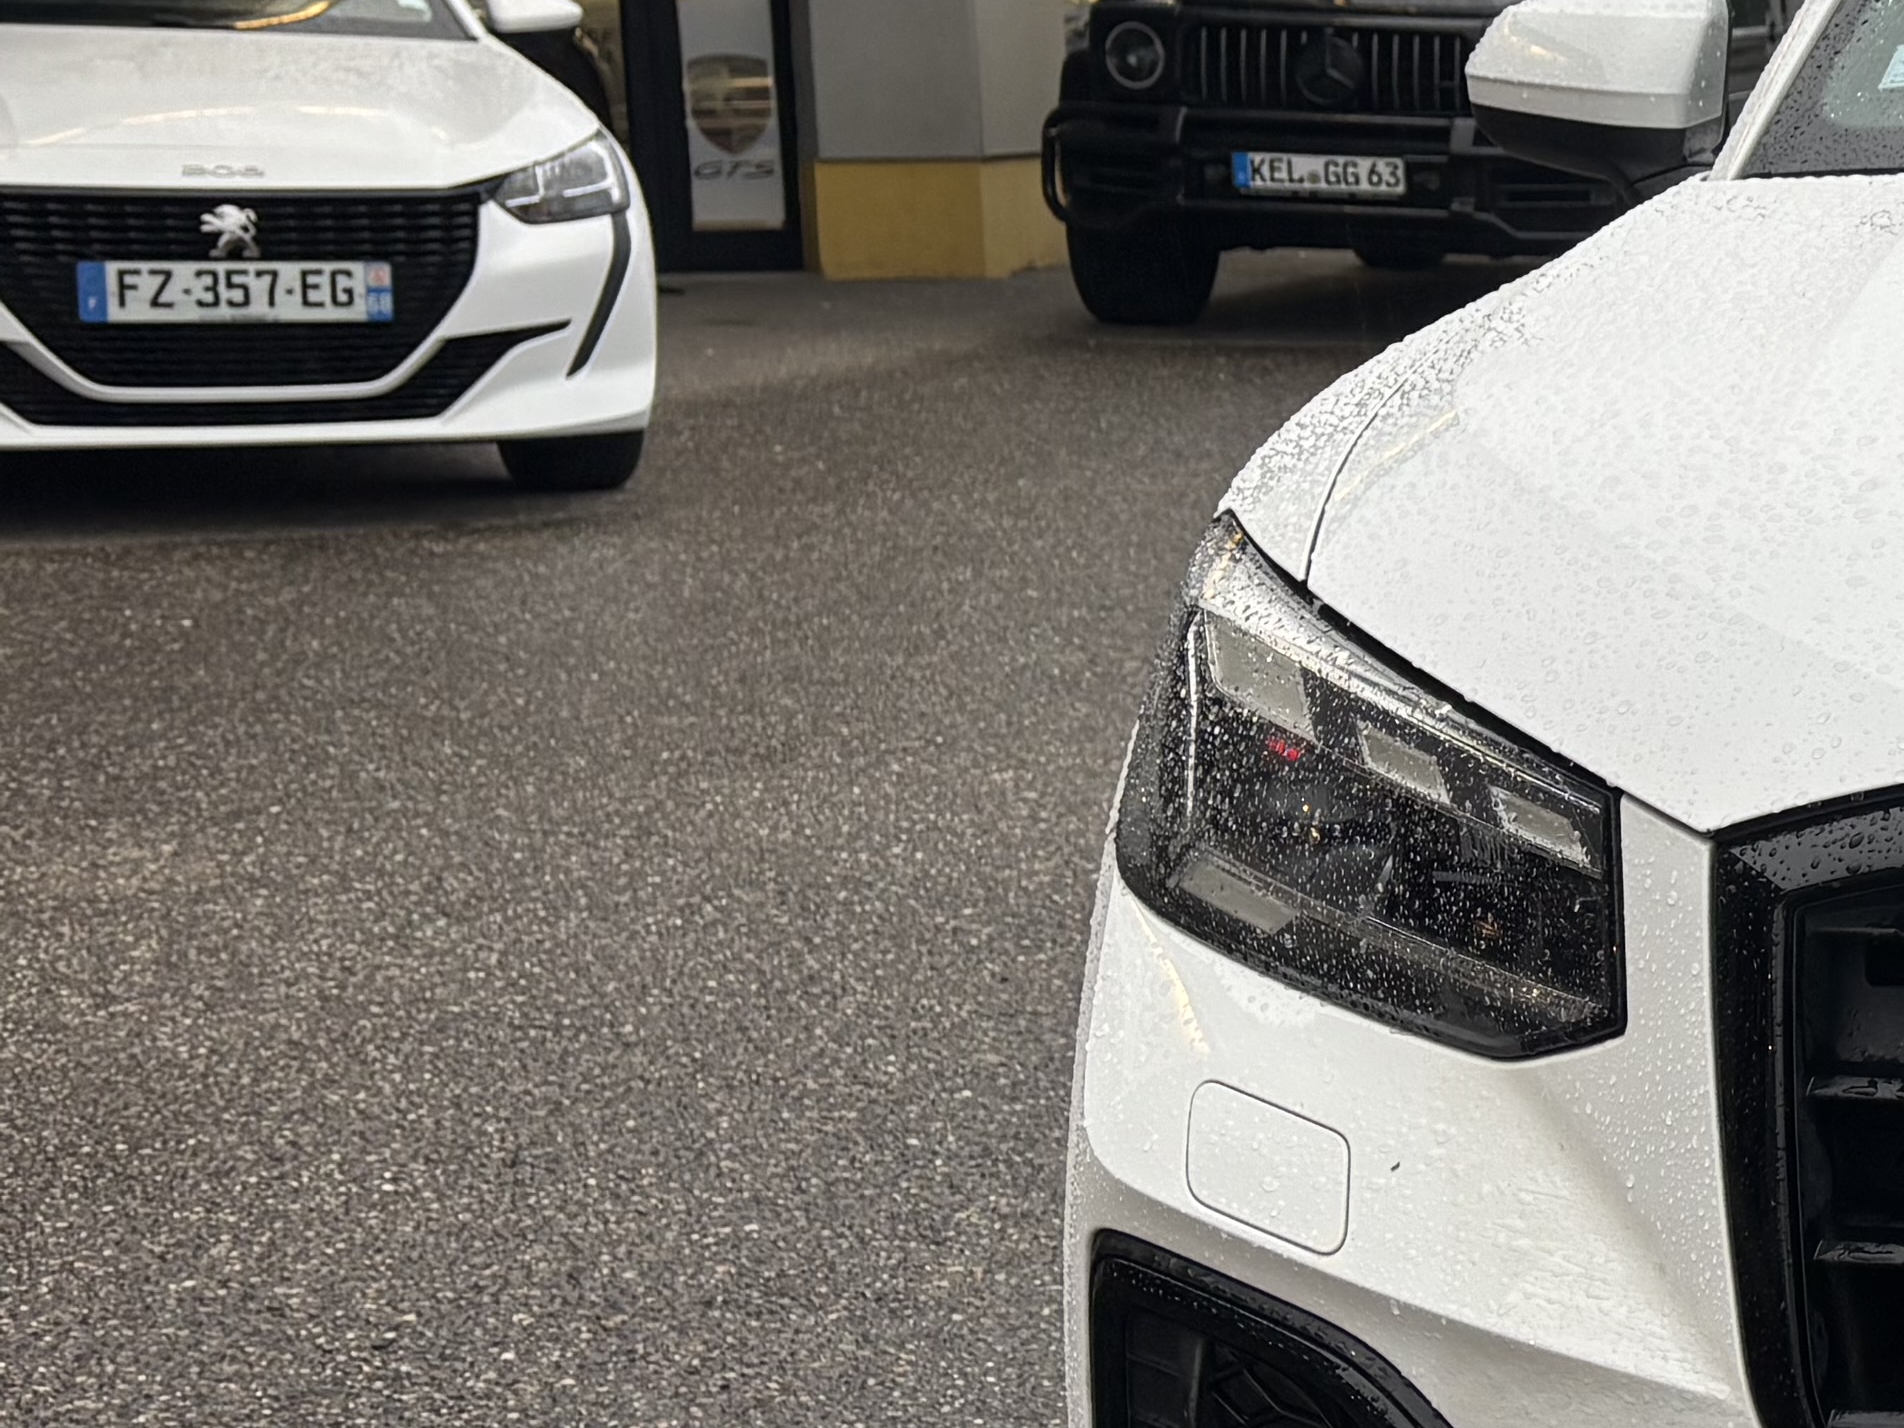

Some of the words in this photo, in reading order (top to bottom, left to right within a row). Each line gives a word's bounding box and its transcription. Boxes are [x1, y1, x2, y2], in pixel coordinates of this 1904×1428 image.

[1250, 156, 1304, 184] KEL
[1323, 158, 1360, 187] GG
[1367, 160, 1400, 188] 63
